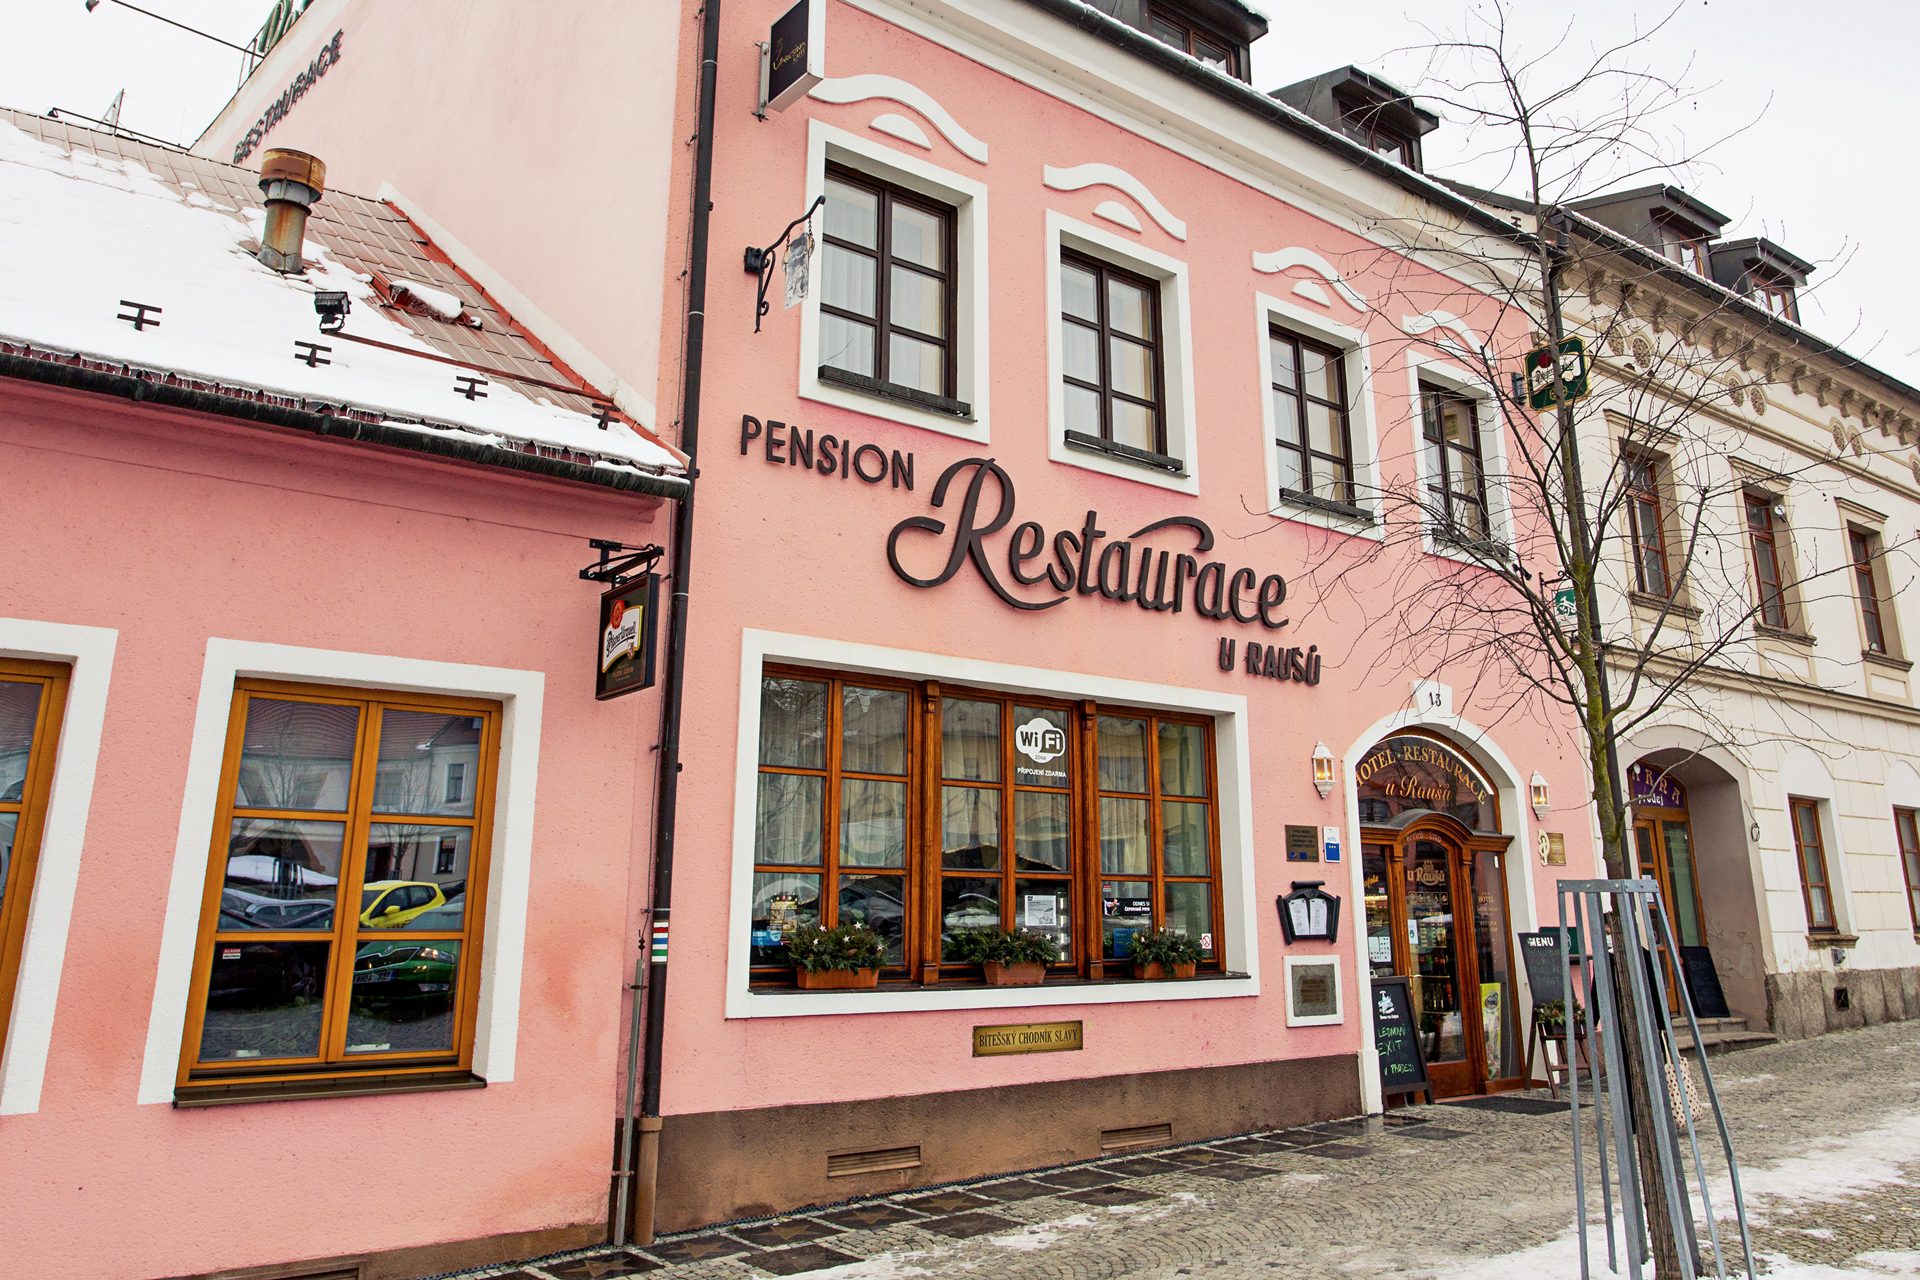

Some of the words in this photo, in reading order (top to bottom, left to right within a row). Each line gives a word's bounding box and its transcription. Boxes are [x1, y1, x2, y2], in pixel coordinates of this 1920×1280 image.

[233, 28, 344, 165] RESTAURACE
[741, 414, 915, 491] PENSION
[887, 457, 1289, 630] Restaurace
[1219, 637, 1236, 671] U
[1246, 641, 1321, 686] RAUŠŮ
[1429, 692, 1442, 707] 13
[1017, 767, 1044, 776] PŘIPOJENÍ
[1403, 745, 1487, 805] RESTAURACE
[1385, 781, 1395, 796] u
[1364, 874, 1379, 888] ofola
[1529, 936, 1554, 947] MENU
[979, 1030, 1017, 1047] BÍTEŠSKÝ
[1018, 1028, 1053, 1044] CHODNÍK
[1055, 1027, 1078, 1042] SLÁVY
[1377, 1040, 1402, 1056] EXIT
